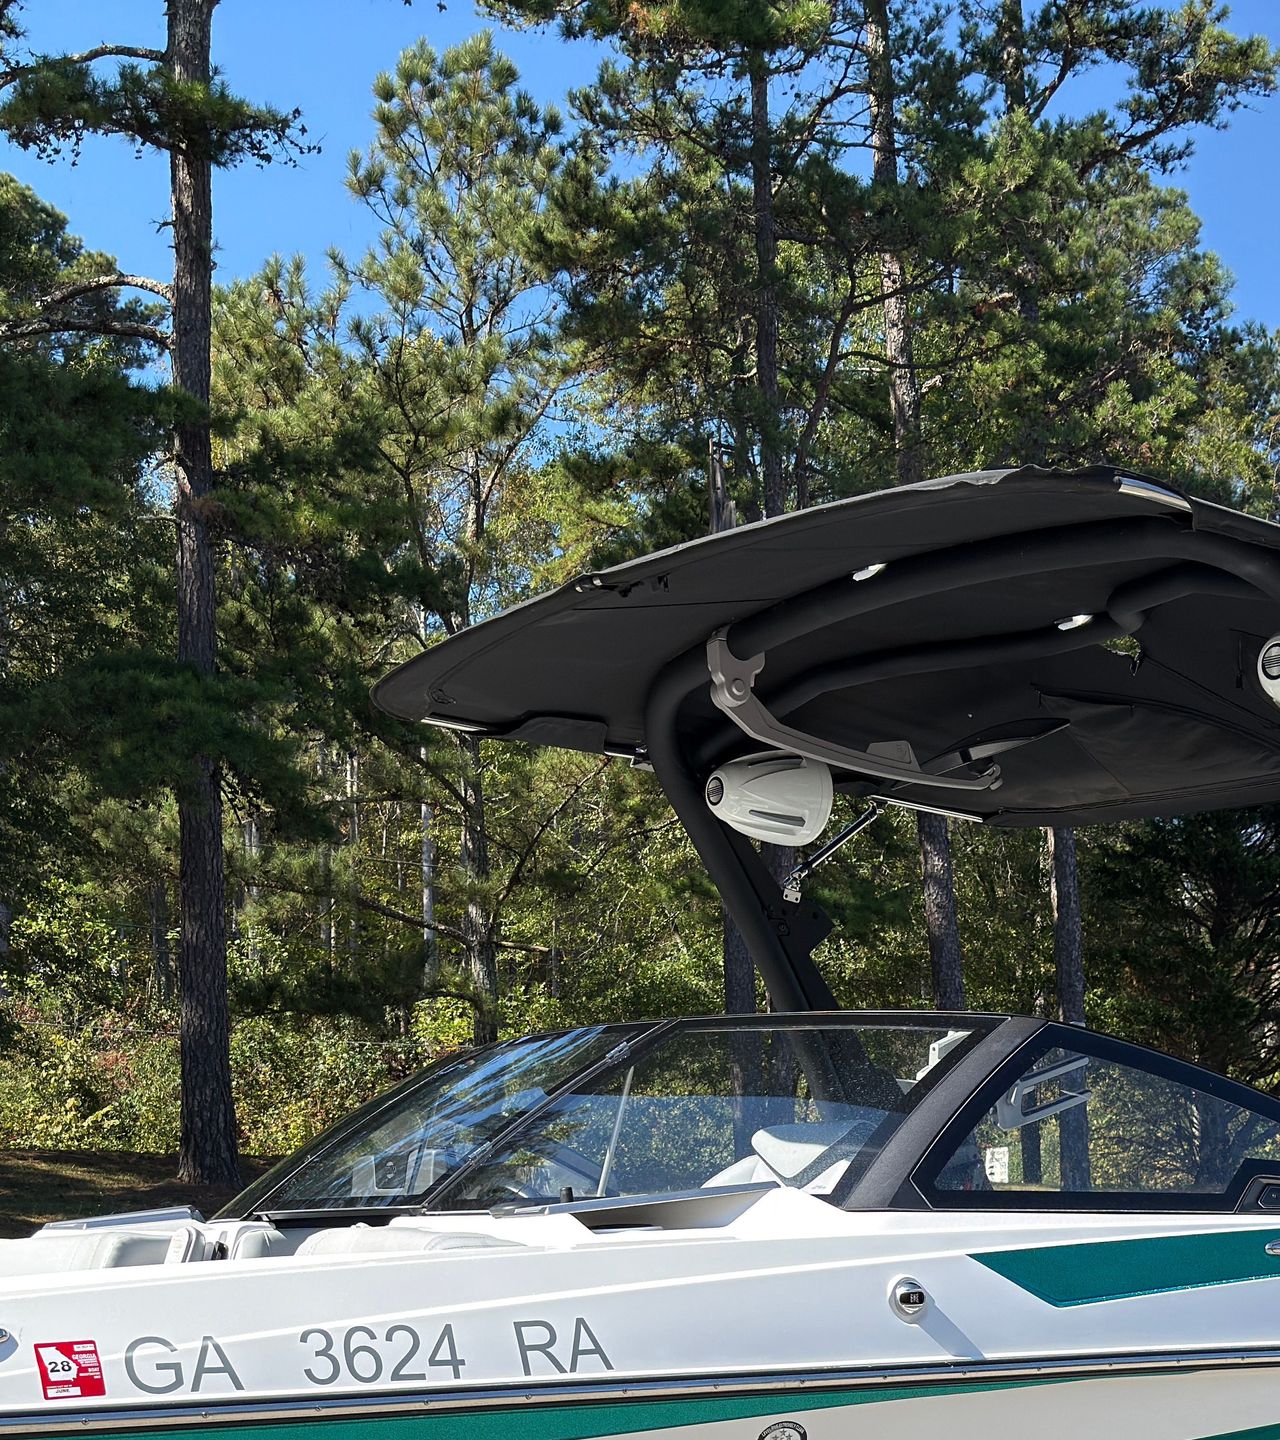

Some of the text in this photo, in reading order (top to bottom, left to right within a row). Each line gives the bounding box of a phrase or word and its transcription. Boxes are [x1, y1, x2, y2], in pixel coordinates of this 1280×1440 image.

[48, 1360, 72, 1373] 28
[124, 1317, 615, 1395] GA 3624 RA
